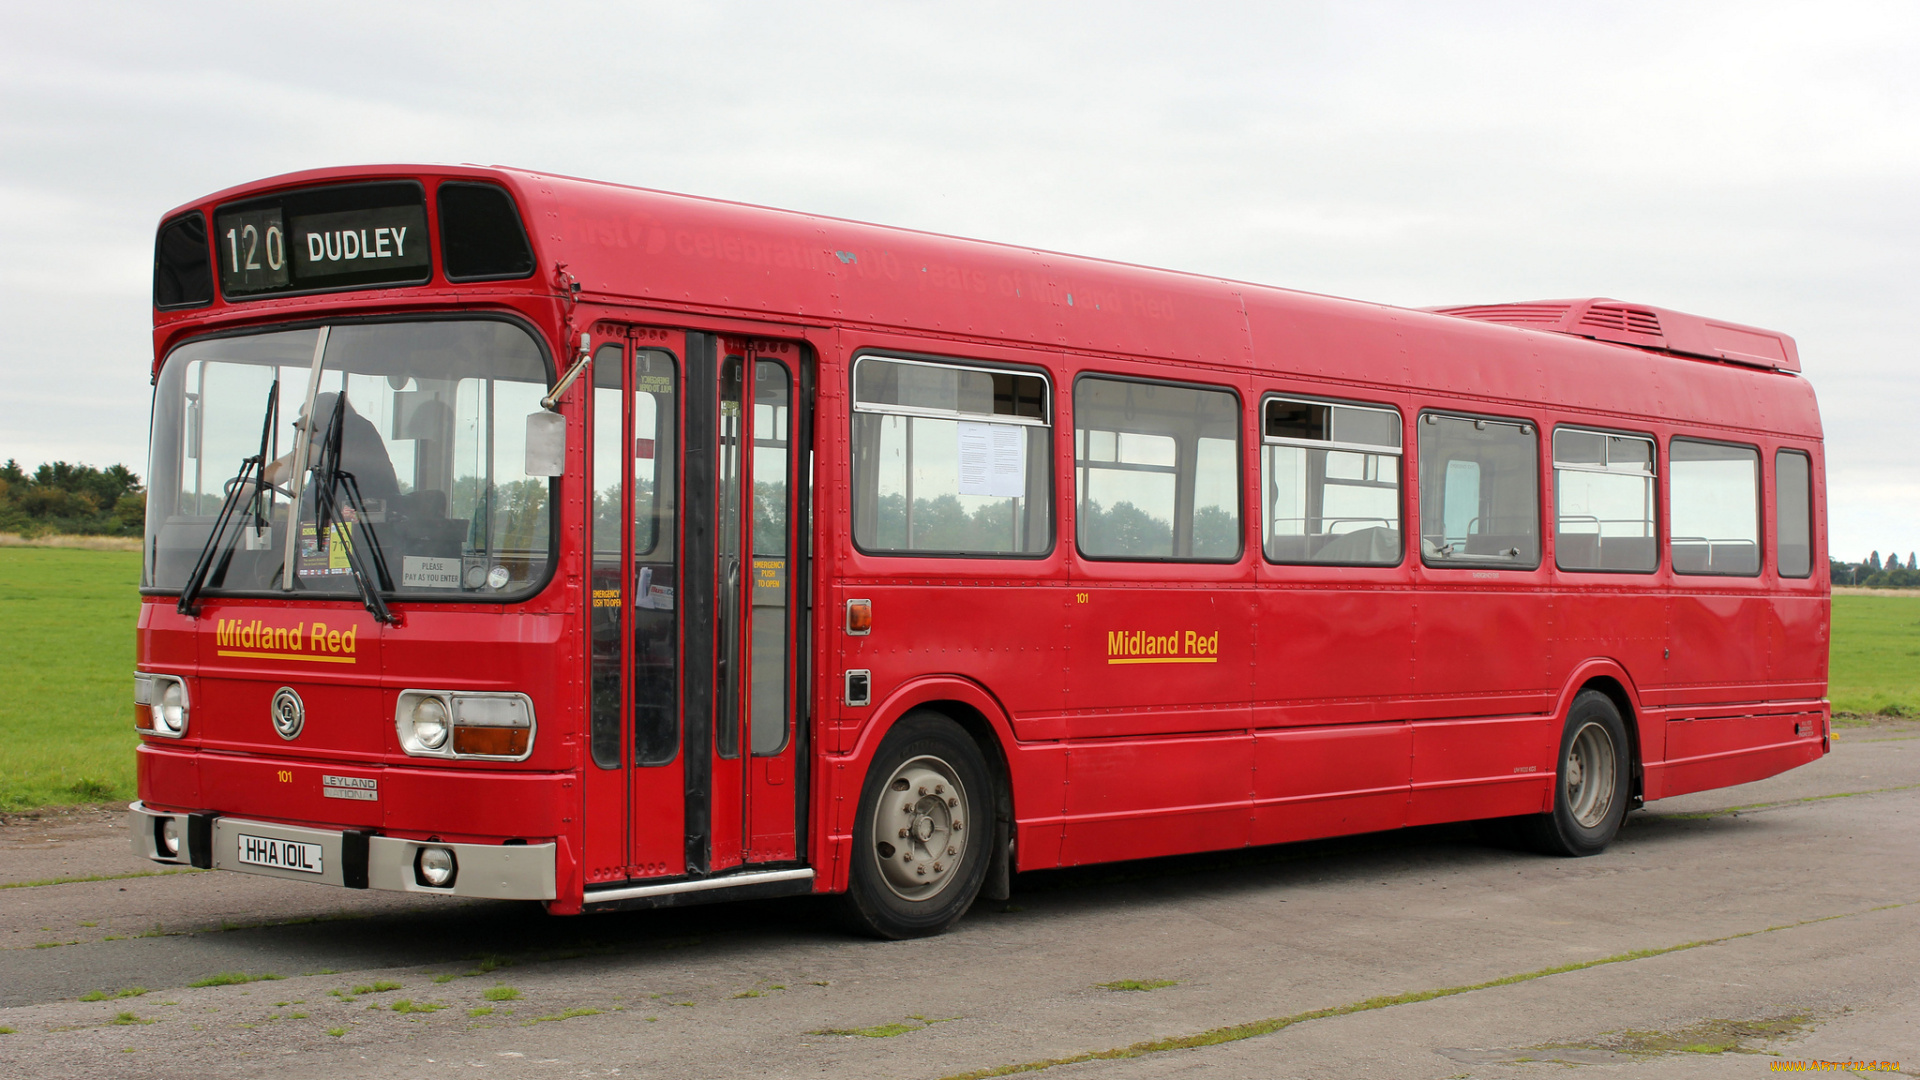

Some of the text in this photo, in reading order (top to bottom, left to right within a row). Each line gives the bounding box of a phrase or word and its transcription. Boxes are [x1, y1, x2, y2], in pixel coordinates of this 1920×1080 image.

[227, 224, 407, 273] 120 DUDLEY
[421, 562, 444, 571] PLEASE
[753, 561, 785, 569] EMERGENCY
[404, 572, 459, 583] PAY AS YOU ENTER
[761, 569, 776, 578] PUSH
[758, 579, 780, 588] TO OPEN
[592, 589, 620, 598] EMERGENCY
[1076, 592, 1089, 604] 101
[592, 599, 603, 607] USH
[216, 618, 358, 654] Midland Red
[1108, 630, 1219, 656] Midland Red
[277, 770, 293, 783] 101
[323, 776, 376, 789] LEYLAND
[246, 838, 279, 865] HHA
